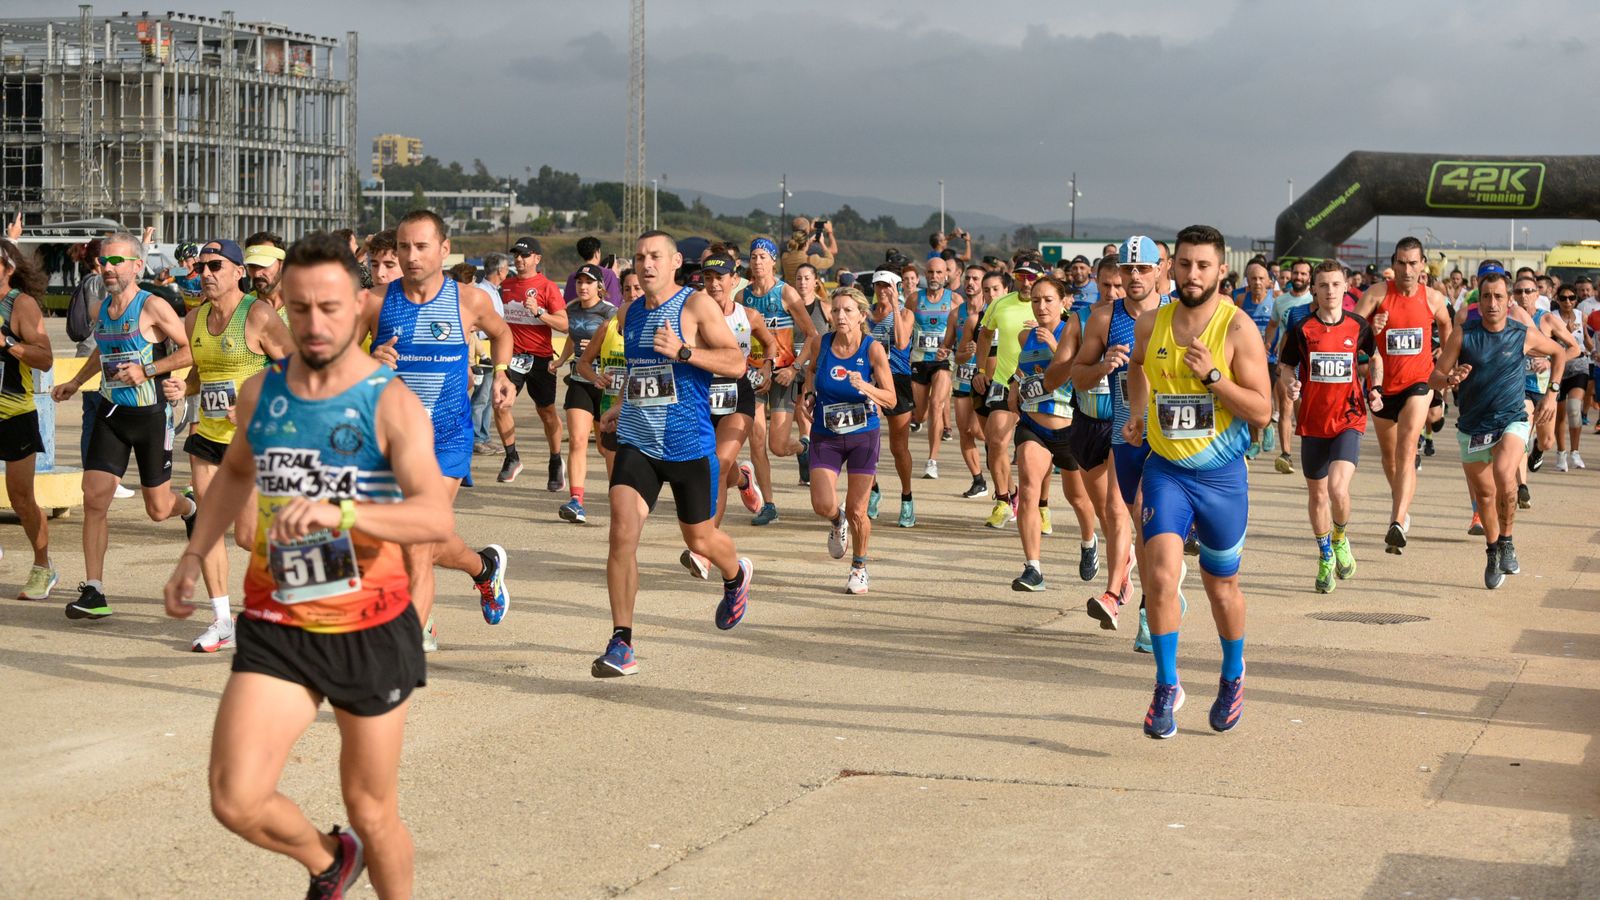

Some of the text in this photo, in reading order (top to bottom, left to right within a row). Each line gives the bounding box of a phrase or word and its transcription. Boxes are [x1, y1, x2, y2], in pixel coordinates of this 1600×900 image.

[1441, 167, 1530, 191] 42K
[1304, 182, 1360, 230] 42krunning.com
[1476, 191, 1525, 205] running
[925, 336, 939, 348] 94
[1394, 334, 1416, 350] 141
[397, 353, 433, 362] tletismo
[1317, 360, 1345, 377] 106
[636, 376, 659, 398] 73
[1026, 380, 1044, 398] 30
[203, 390, 230, 411] 129
[708, 392, 725, 408] 17
[836, 410, 854, 428] 21
[1169, 405, 1197, 430] 79
[267, 452, 319, 471] TRAIL
[262, 470, 353, 498] TEAM 3x4
[282, 547, 327, 587] 51
